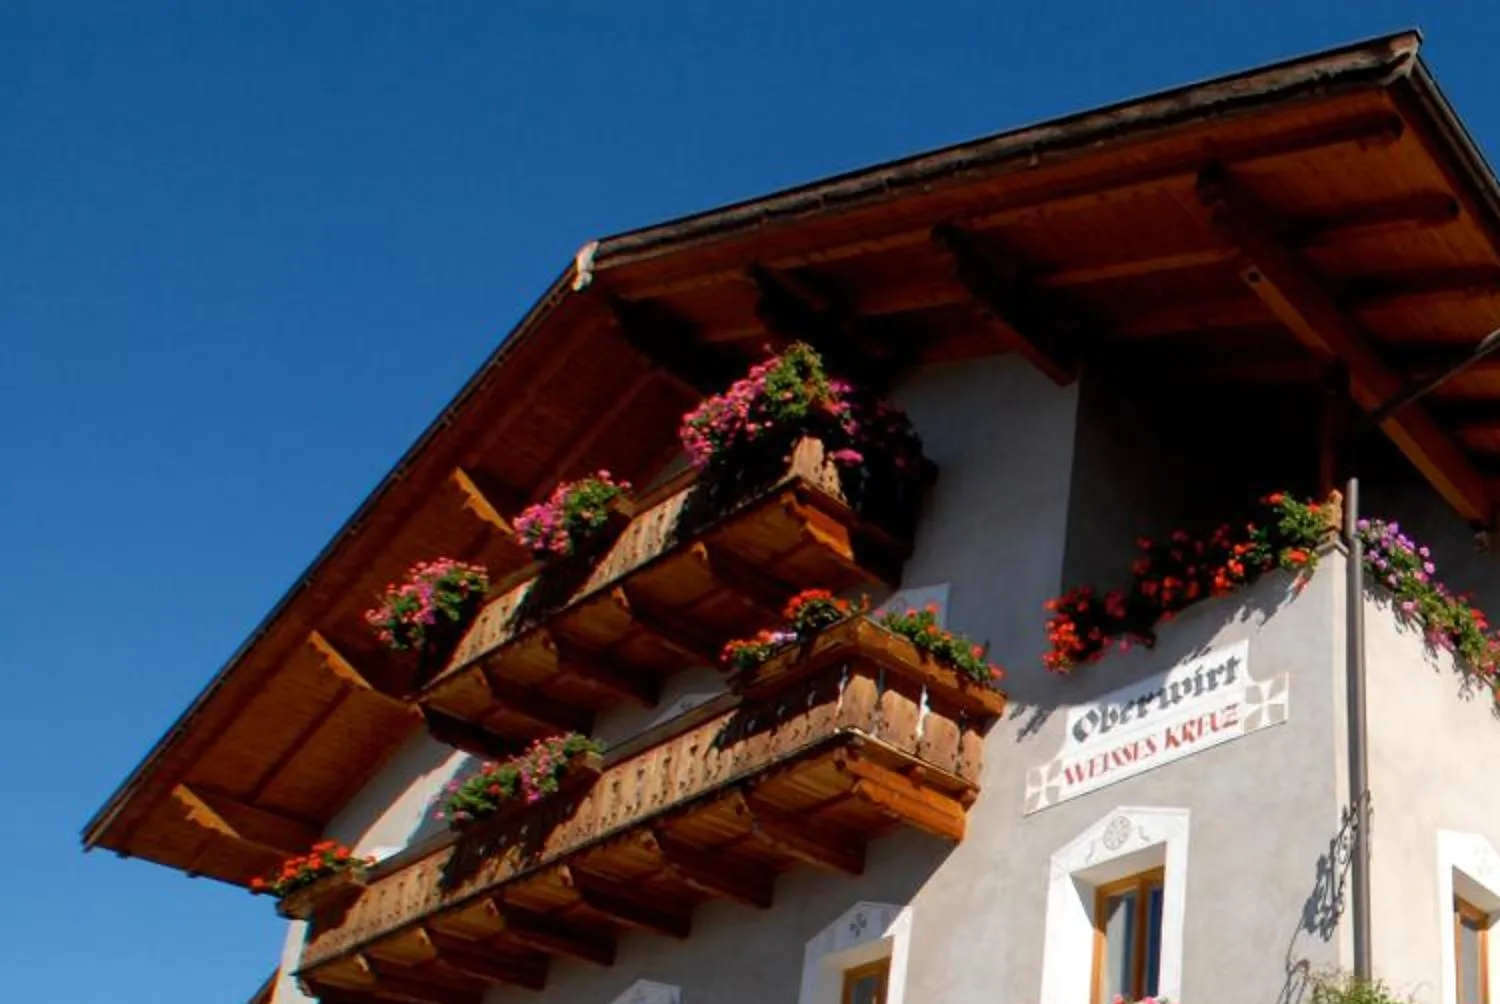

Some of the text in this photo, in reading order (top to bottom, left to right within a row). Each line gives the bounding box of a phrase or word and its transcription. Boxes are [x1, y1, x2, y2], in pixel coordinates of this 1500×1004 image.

[1071, 655, 1241, 744] Oberwirt
[1064, 702, 1240, 785] WEISSES KREUZ
